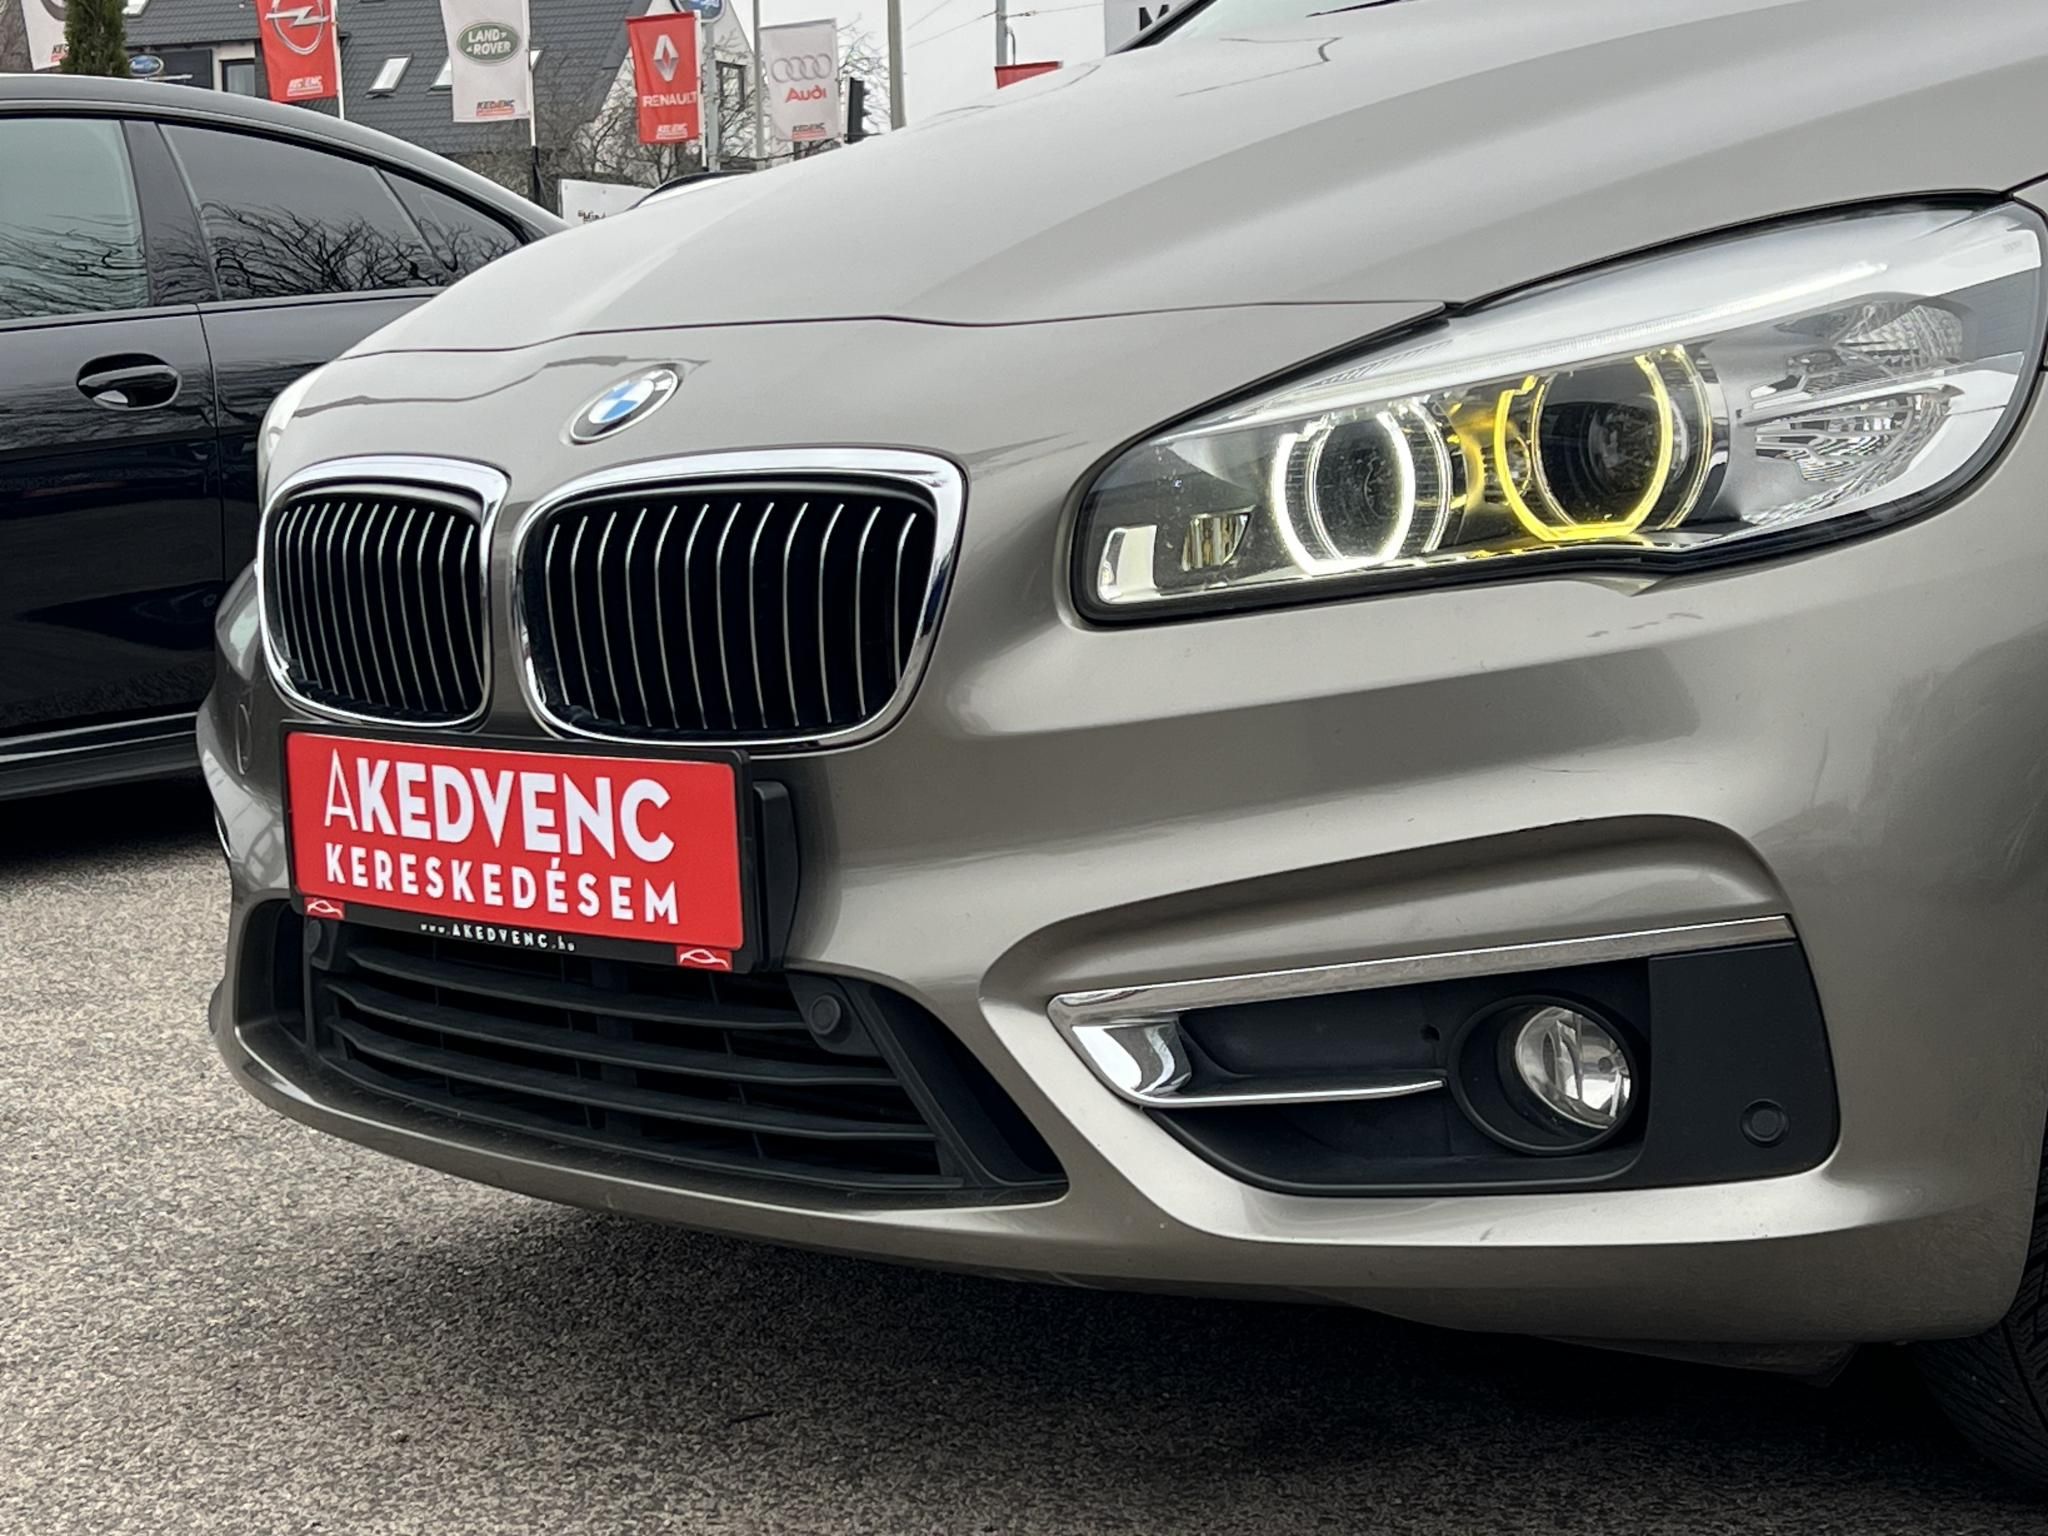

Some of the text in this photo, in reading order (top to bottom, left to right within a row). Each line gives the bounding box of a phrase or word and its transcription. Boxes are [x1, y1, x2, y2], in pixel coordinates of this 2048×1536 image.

[467, 28, 500, 43] LAND
[473, 41, 511, 55] ROVER
[642, 91, 697, 107] RENAULT
[785, 84, 827, 103] Audi
[323, 747, 675, 863] AKEDVENC
[324, 842, 679, 925] KERESKEDÉSEM
[420, 923, 575, 951] www.AKEDVENC.hu
